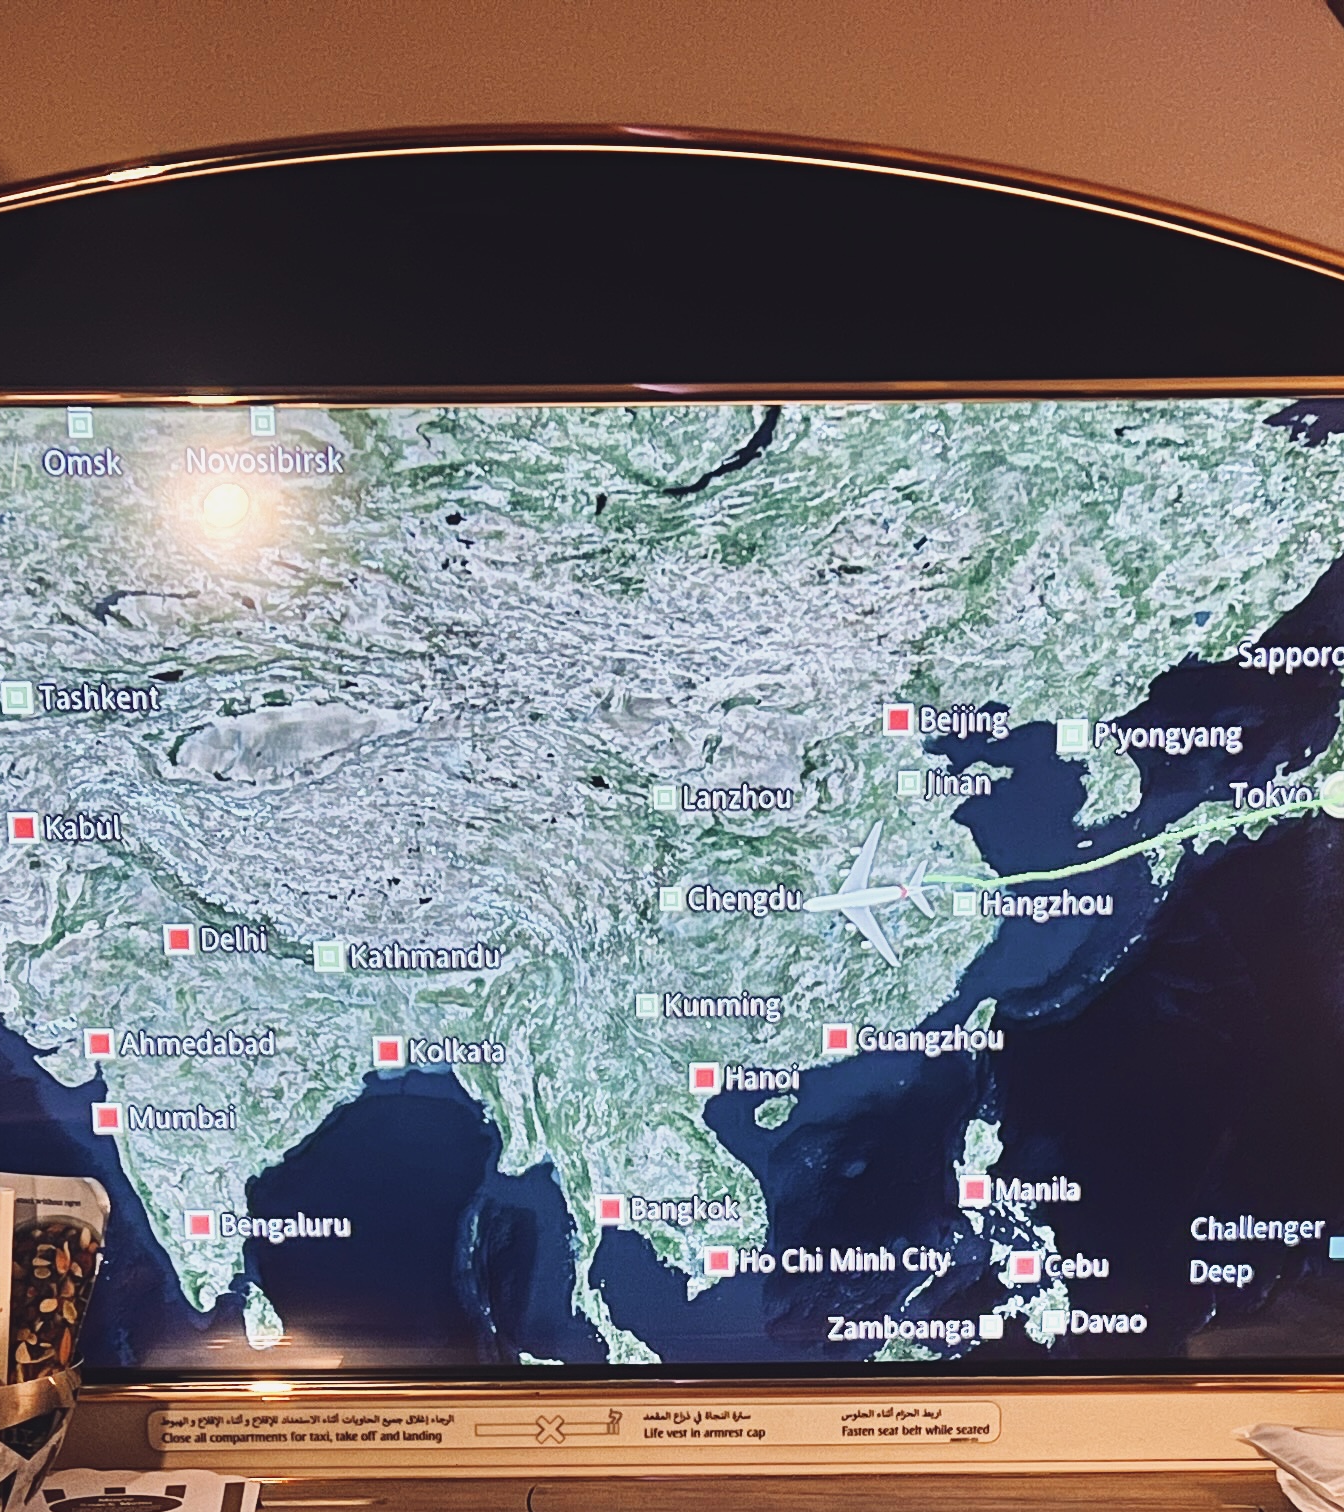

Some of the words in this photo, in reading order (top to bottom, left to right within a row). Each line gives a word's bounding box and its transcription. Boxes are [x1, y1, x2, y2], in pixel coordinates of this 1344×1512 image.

[43, 449, 121, 476] Omsk
[186, 447, 343, 474] Novosibirsk
[38, 684, 158, 711] Tashkent
[920, 706, 1009, 738] Beijing
[1095, 723, 1243, 753] P'yongyang
[683, 785, 793, 810] Lanzhou
[925, 770, 991, 799] Jinan
[1230, 782, 1312, 809] Tokyo
[44, 815, 121, 840] Kabul
[688, 885, 802, 916] Chengdu
[981, 892, 1113, 922] Hangzhou
[200, 925, 267, 952] Delhi
[351, 945, 501, 970] Kathmandu
[664, 992, 781, 1020] Kunming
[121, 1032, 275, 1056] Ahmedabad
[409, 1039, 505, 1063] Kolkata
[858, 1026, 1003, 1056] Guangzhou
[725, 1064, 799, 1090] Hanoi
[129, 1106, 236, 1129] Mumbai
[996, 1176, 1081, 1202] Manila
[630, 1197, 739, 1223] Bangkok
[221, 1214, 351, 1242] Bengaluru
[1191, 1216, 1325, 1246] Challenger
[740, 1249, 772, 1274] Ho
[782, 1247, 823, 1273] Chi
[830, 1246, 895, 1271] Minh
[902, 1247, 951, 1275] City
[1045, 1253, 1109, 1278] Cebu
[1190, 1260, 1254, 1288] Deep
[827, 1315, 975, 1343] Zamboanga
[1070, 1310, 1147, 1334] Davao
[161, 1432, 191, 1443] Close
[194, 1432, 207, 1443] all
[210, 1432, 287, 1445] compartments
[291, 1431, 307, 1442] for
[309, 1431, 333, 1443] taxi,
[335, 1431, 358, 1442] take
[361, 1430, 377, 1441] off
[380, 1430, 400, 1441] and
[403, 1430, 442, 1443] landing
[644, 1428, 664, 1438] Life
[666, 1429, 687, 1438] vest
[691, 1428, 701, 1438] in
[704, 1428, 743, 1438] armrest
[746, 1428, 766, 1440] cap
[842, 1426, 874, 1436] Fasten
[877, 1425, 898, 1436] seat
[902, 1425, 923, 1435] belt
[925, 1425, 954, 1435] while
[956, 1424, 990, 1434] seated
